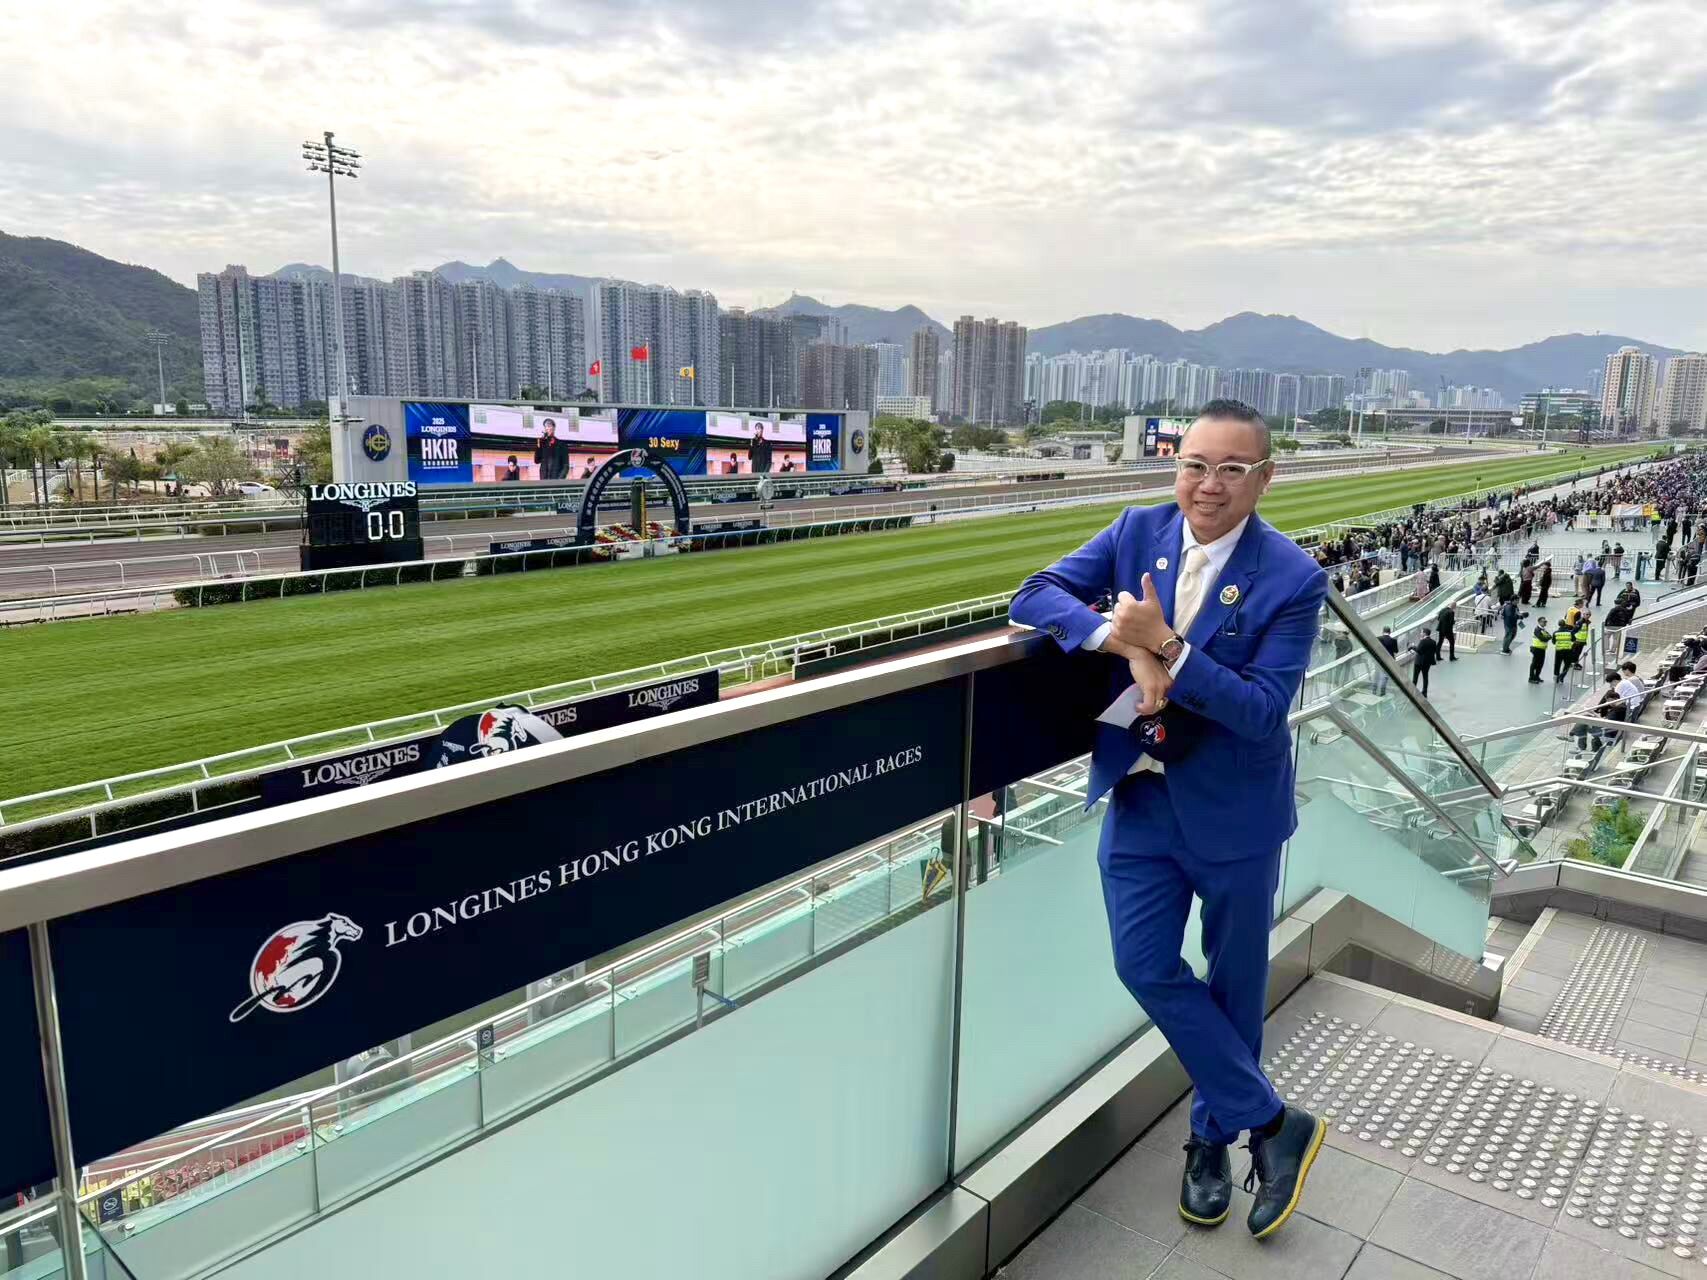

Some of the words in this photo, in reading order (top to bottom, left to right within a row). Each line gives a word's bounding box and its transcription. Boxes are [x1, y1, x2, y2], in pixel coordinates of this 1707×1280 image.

[421, 425, 457, 433] LONGINES
[421, 438, 459, 460] HKIR
[648, 436, 659, 448] 30
[660, 436, 680, 450] Sexy
[812, 438, 832, 454] HKIR
[310, 481, 417, 501] LONGINES
[628, 678, 700, 708] LONGINES
[301, 743, 421, 788] LONGINES
[384, 869, 552, 948] LONGINES
[558, 840, 640, 887] HONG
[645, 815, 712, 857] KONG
[716, 763, 873, 832] INTERNATIONAL
[875, 745, 923, 777] RACES
